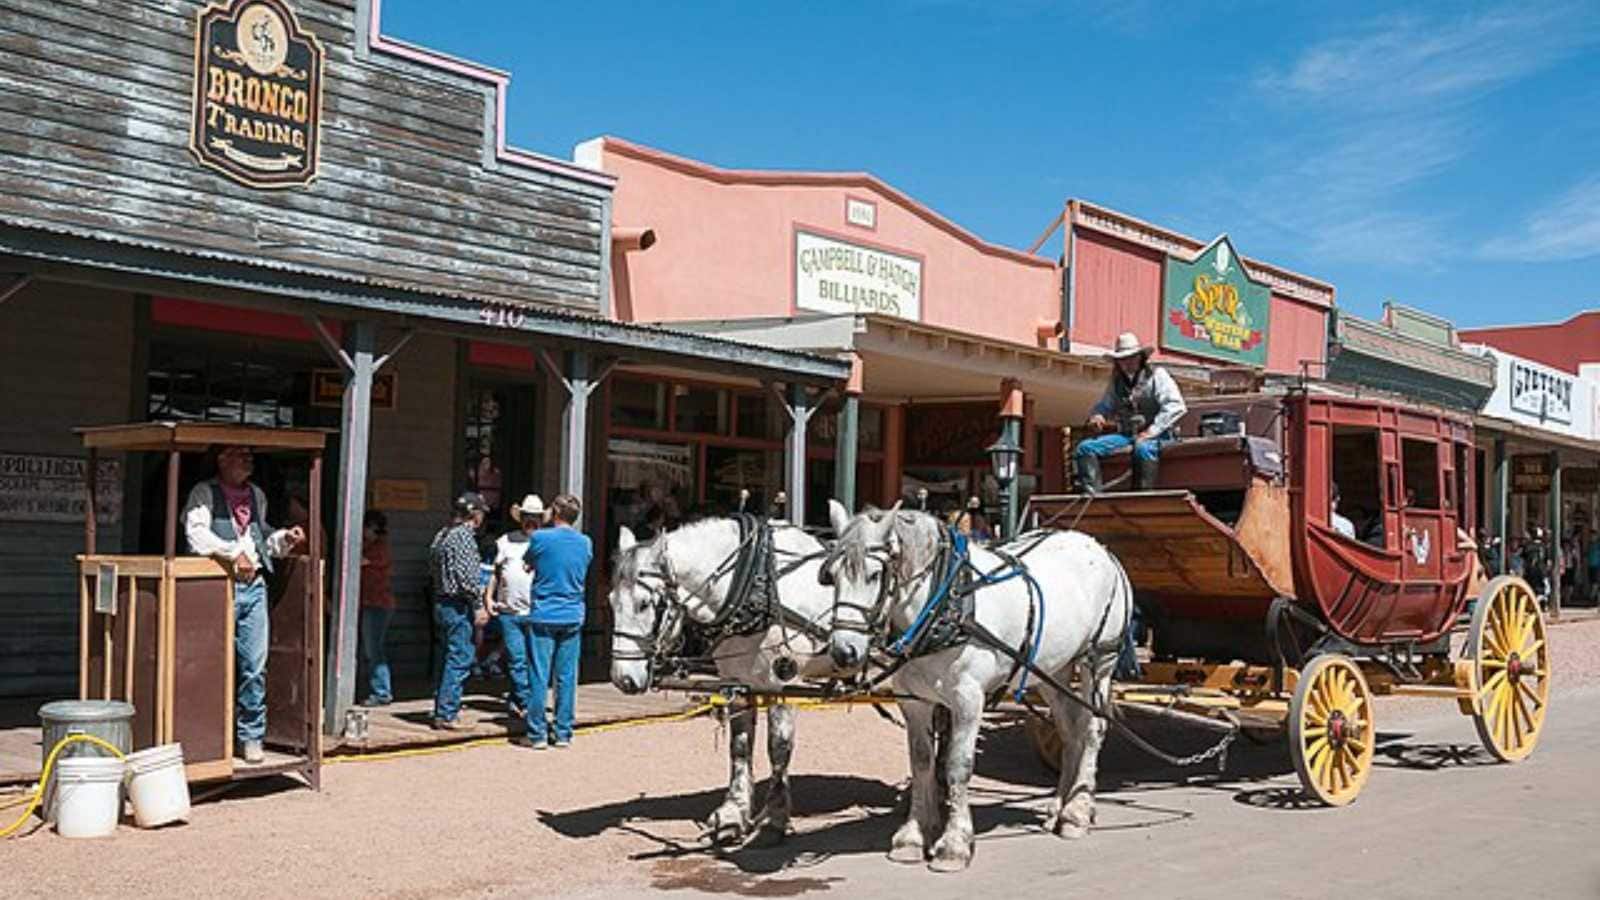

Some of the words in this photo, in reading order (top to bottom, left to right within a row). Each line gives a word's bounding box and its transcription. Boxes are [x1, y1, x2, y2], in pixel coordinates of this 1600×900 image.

[207, 66, 308, 123] BRONCO
[207, 102, 306, 150] TRADING
[800, 246, 863, 277] CAMPBELL
[878, 257, 917, 298] HATCH
[818, 279, 901, 315] BILLIARDS
[1514, 364, 1573, 412] STETSON
